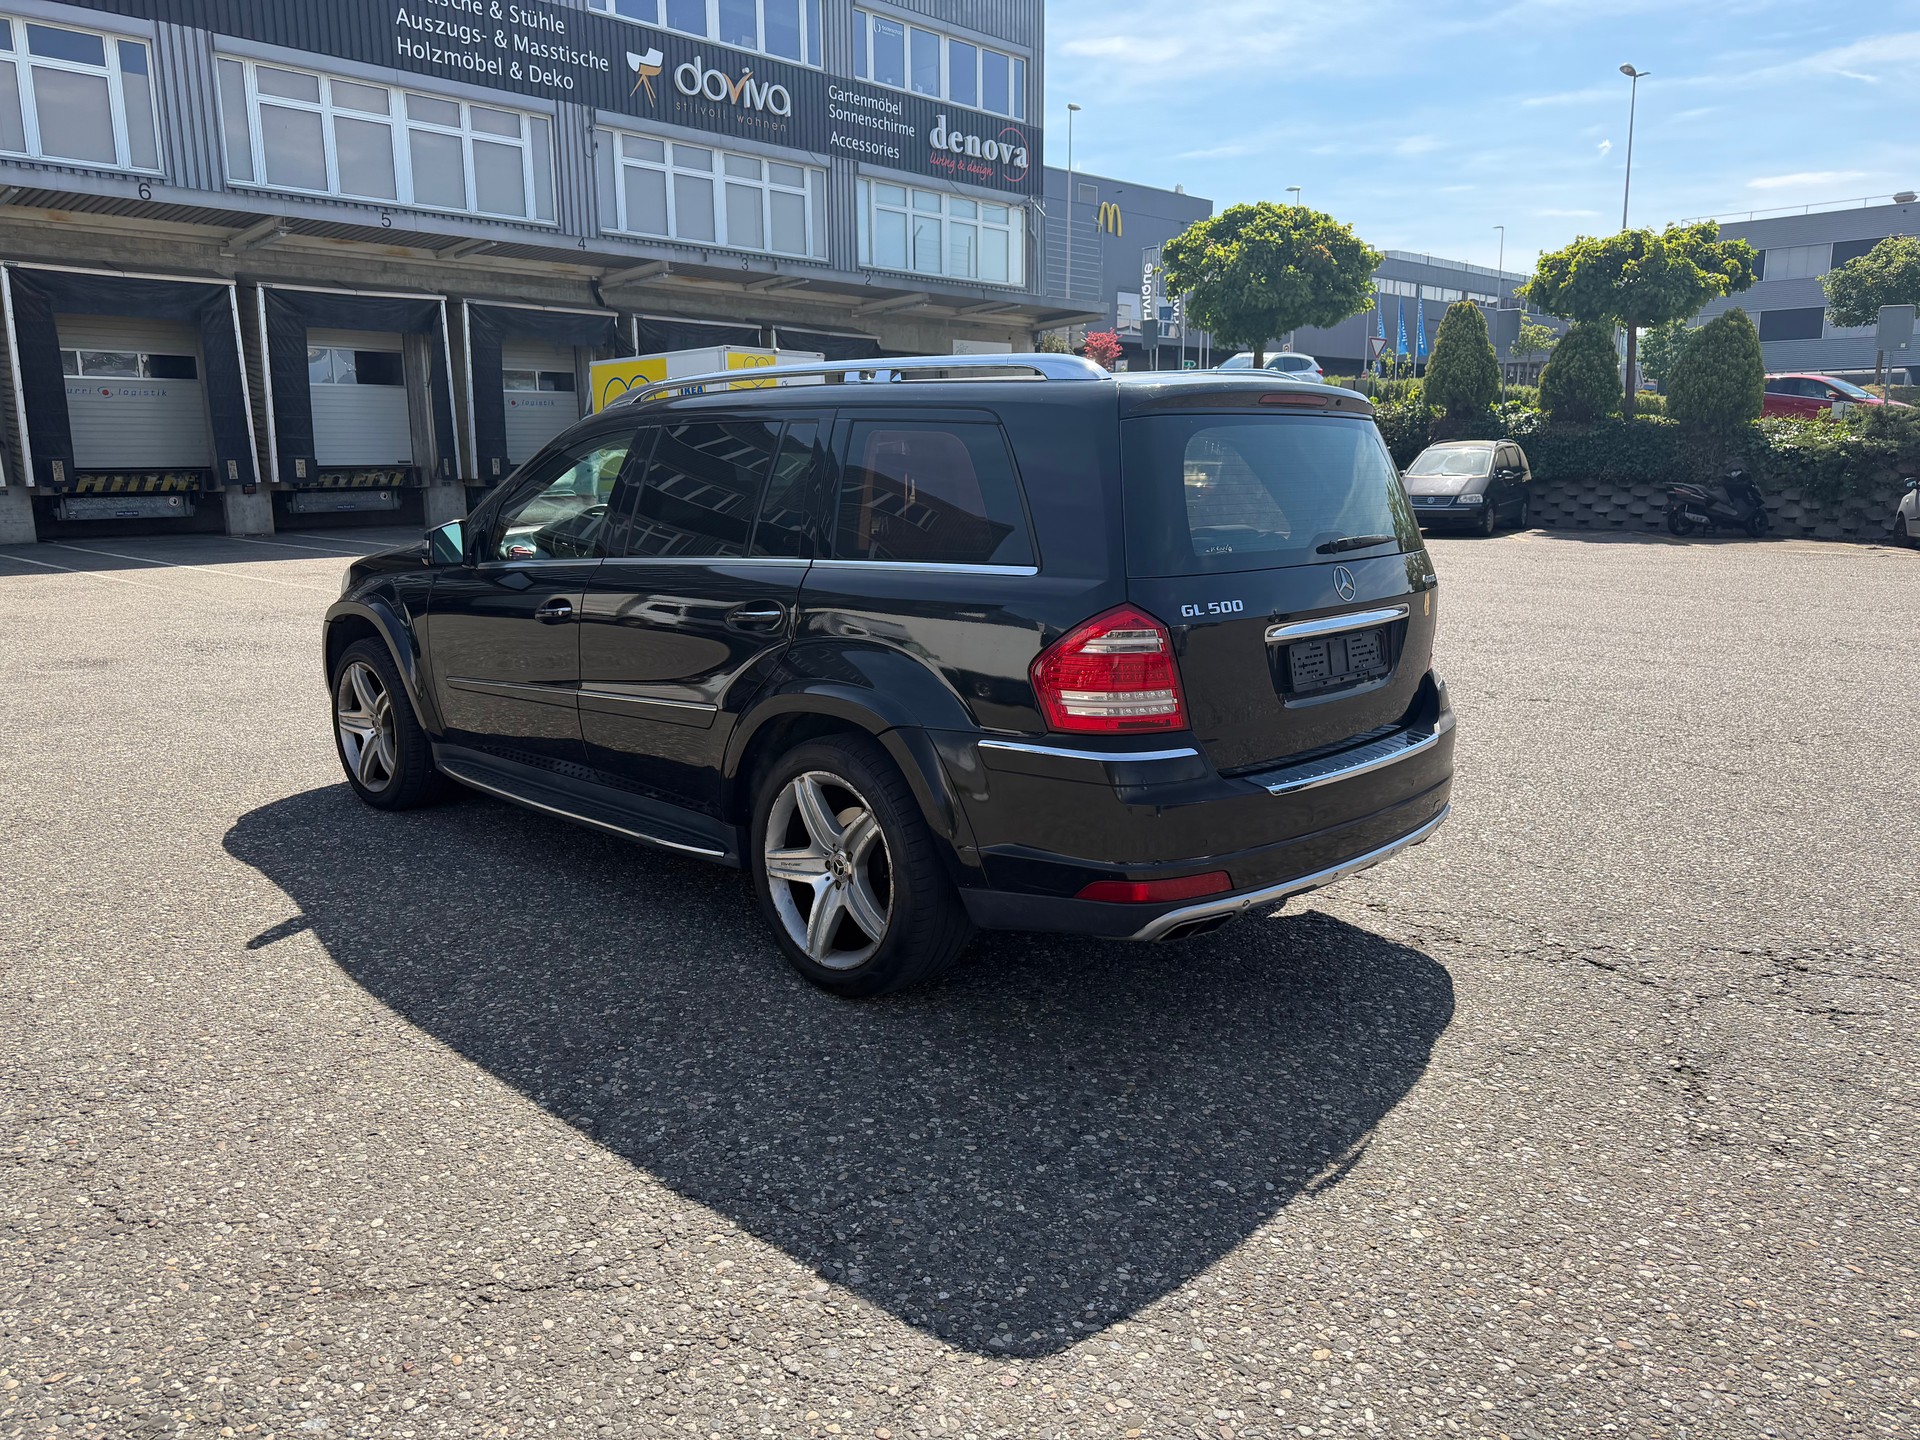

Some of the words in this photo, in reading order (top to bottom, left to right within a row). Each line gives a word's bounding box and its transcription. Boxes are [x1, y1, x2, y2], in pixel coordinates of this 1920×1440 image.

[489, 1, 502, 20] &
[509, 5, 565, 34] Stühle
[396, 8, 487, 44] Auszugs-
[494, 30, 507, 48] &
[514, 34, 609, 71] Masstische
[397, 37, 502, 75] Holzmöbel
[510, 62, 522, 80] &
[529, 65, 574, 89] Deko
[674, 56, 791, 117] doviva
[828, 85, 902, 116] Gartenmöbel
[675, 101, 726, 119] stilvoll
[736, 114, 787, 132] wohnen
[828, 104, 915, 137] Sonnenschirme
[830, 131, 900, 159] Accessories
[929, 114, 1029, 169] denova
[930, 152, 956, 174] living
[957, 160, 965, 171] &
[967, 161, 993, 180] design
[138, 183, 151, 201] 6
[381, 213, 391, 228] 5
[577, 237, 586, 250] 4
[741, 258, 749, 271] 3
[865, 273, 871, 286] 2
[118, 388, 168, 397] logistik
[681, 385, 704, 396] IKEA
[1181, 604, 1205, 617] GL
[1207, 600, 1244, 615] 500
